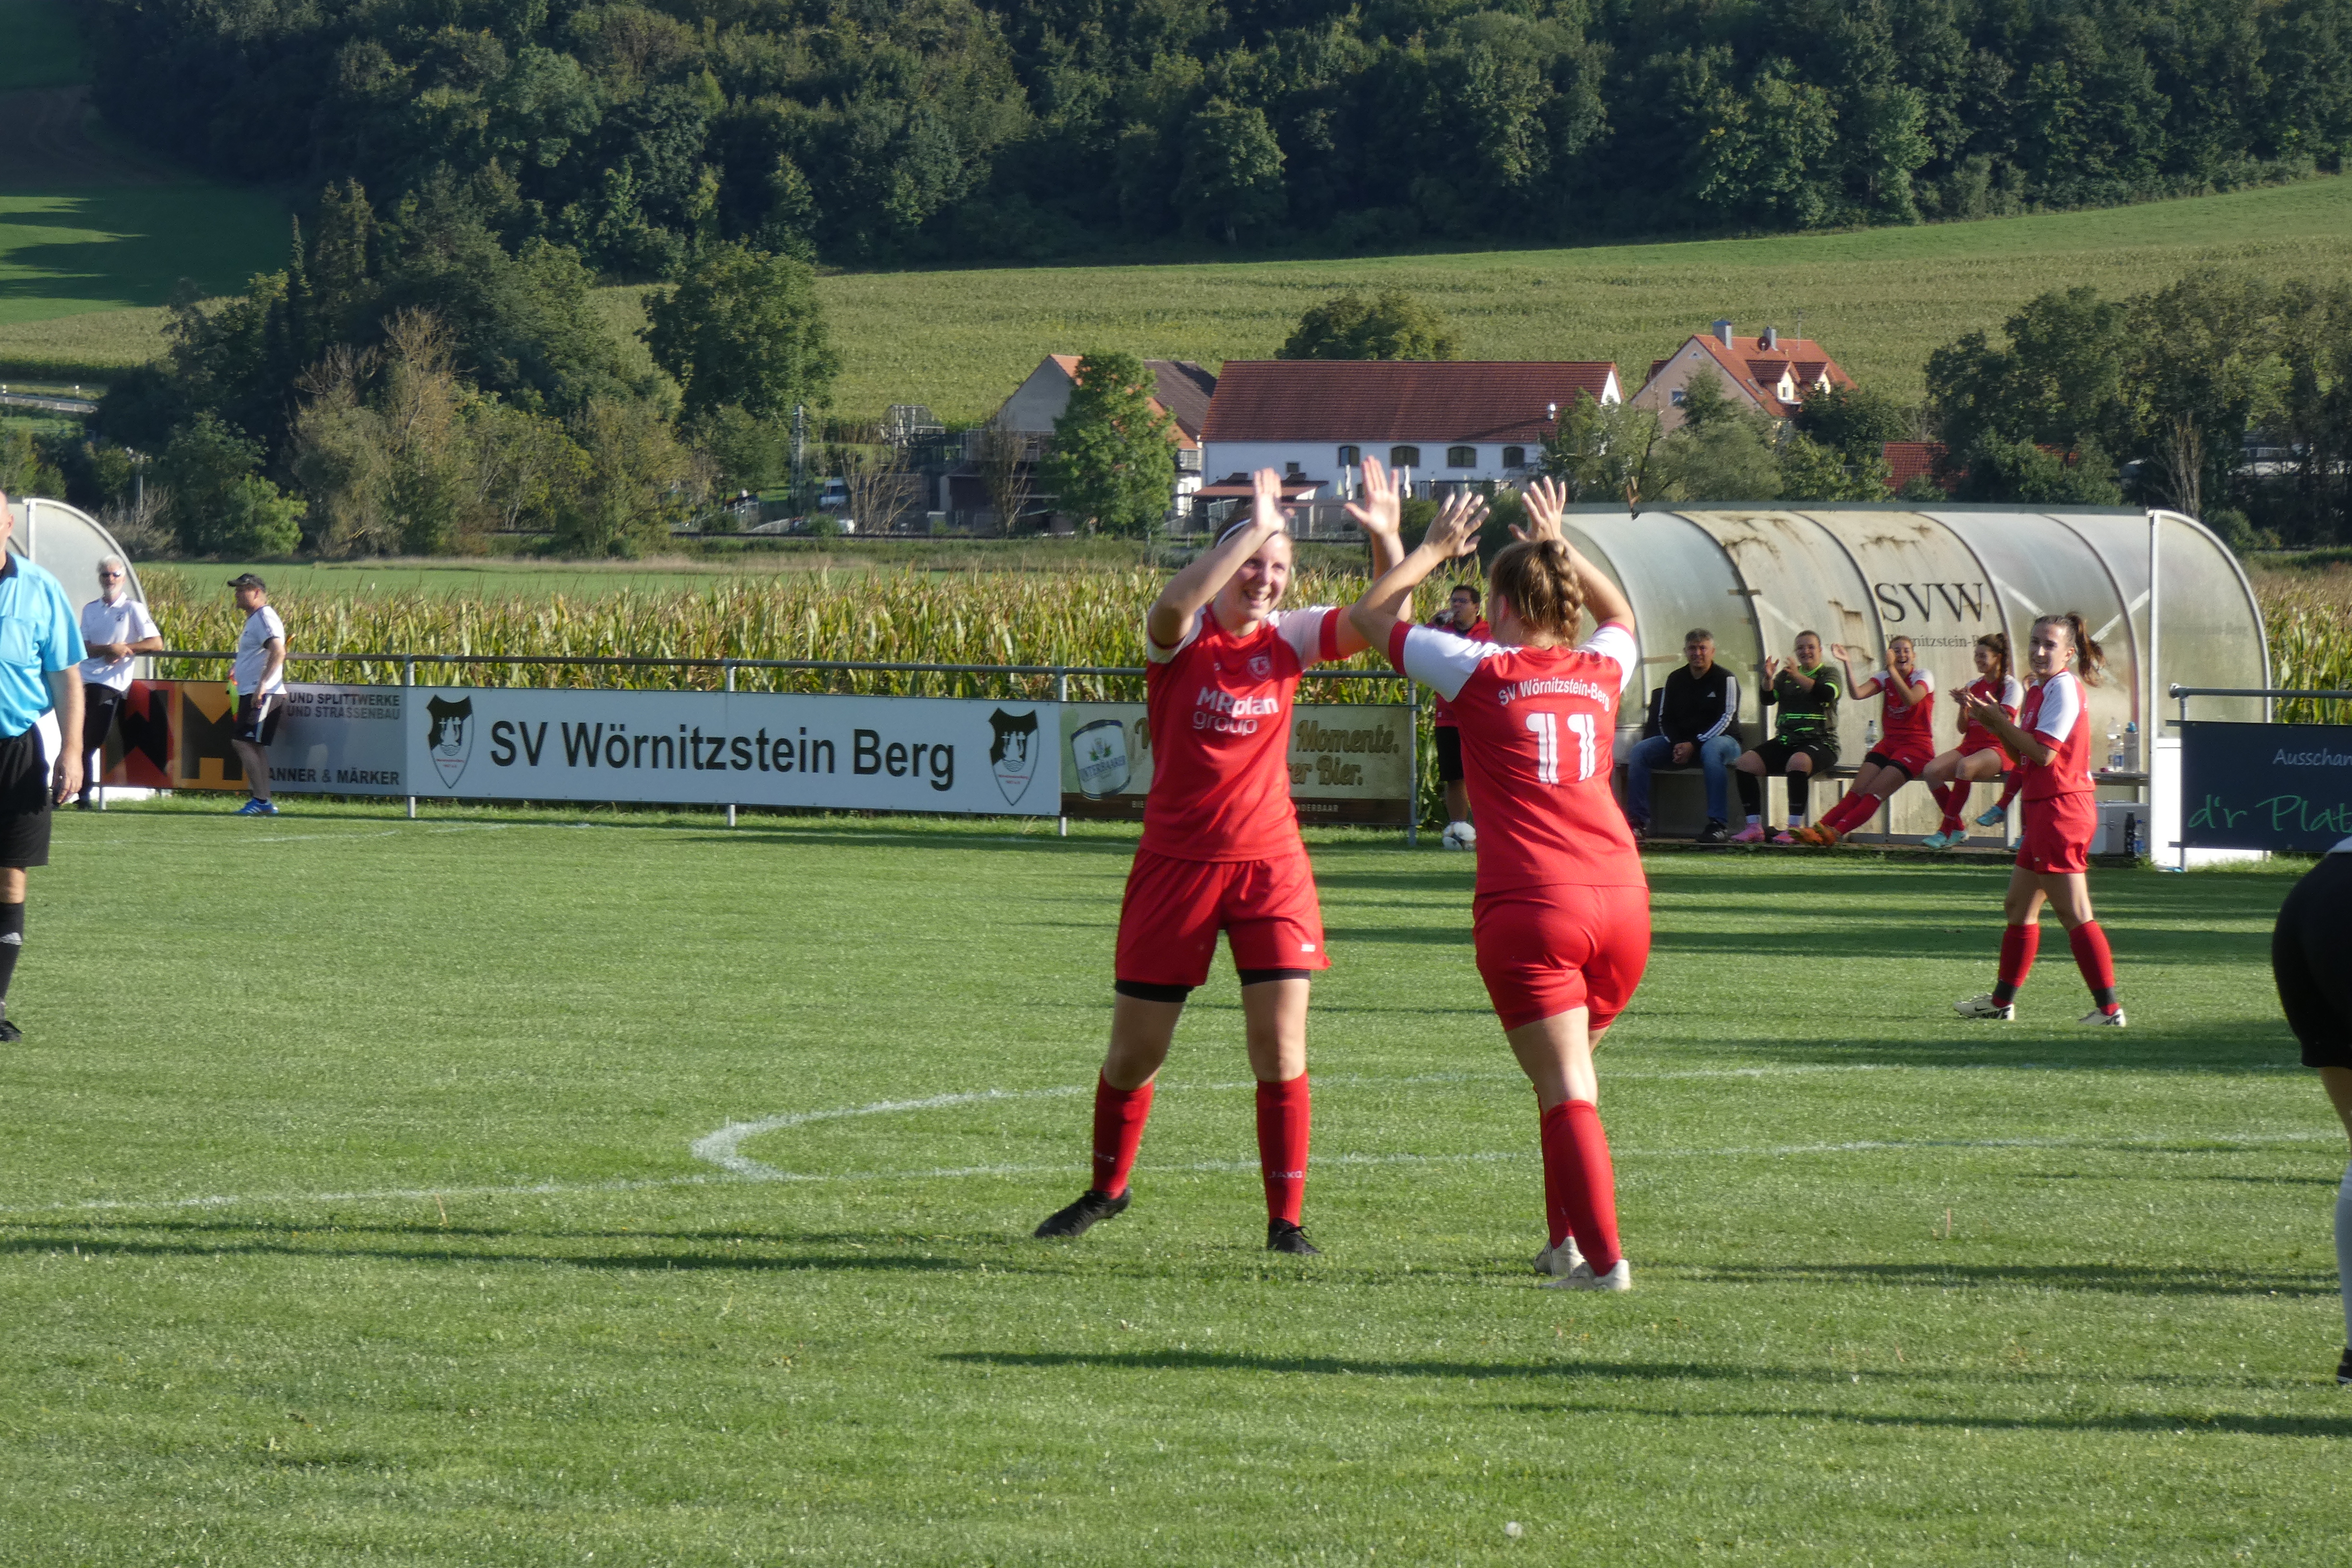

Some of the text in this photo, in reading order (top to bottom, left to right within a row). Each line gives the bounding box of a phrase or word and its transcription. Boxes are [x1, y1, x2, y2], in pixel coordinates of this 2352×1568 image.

[1874, 583, 1984, 622] SVW
[289, 692, 400, 706] UND SPLITTWERKE
[1196, 686, 1279, 717] MRplan
[1498, 676, 1610, 712] SV Wörnitzstein-Berg
[288, 705, 401, 720] UND STRASSENBAU
[1192, 711, 1258, 736] group
[1295, 720, 1399, 754] Momente.
[1526, 713, 1596, 784] 11
[490, 721, 954, 792] SV Wörnitzstein Berg
[1316, 755, 1363, 785] Bier.
[2273, 748, 2352, 766] Ausschan
[269, 767, 400, 785] ANNER & MÄRKER
[2254, 795, 2352, 833] Plat
